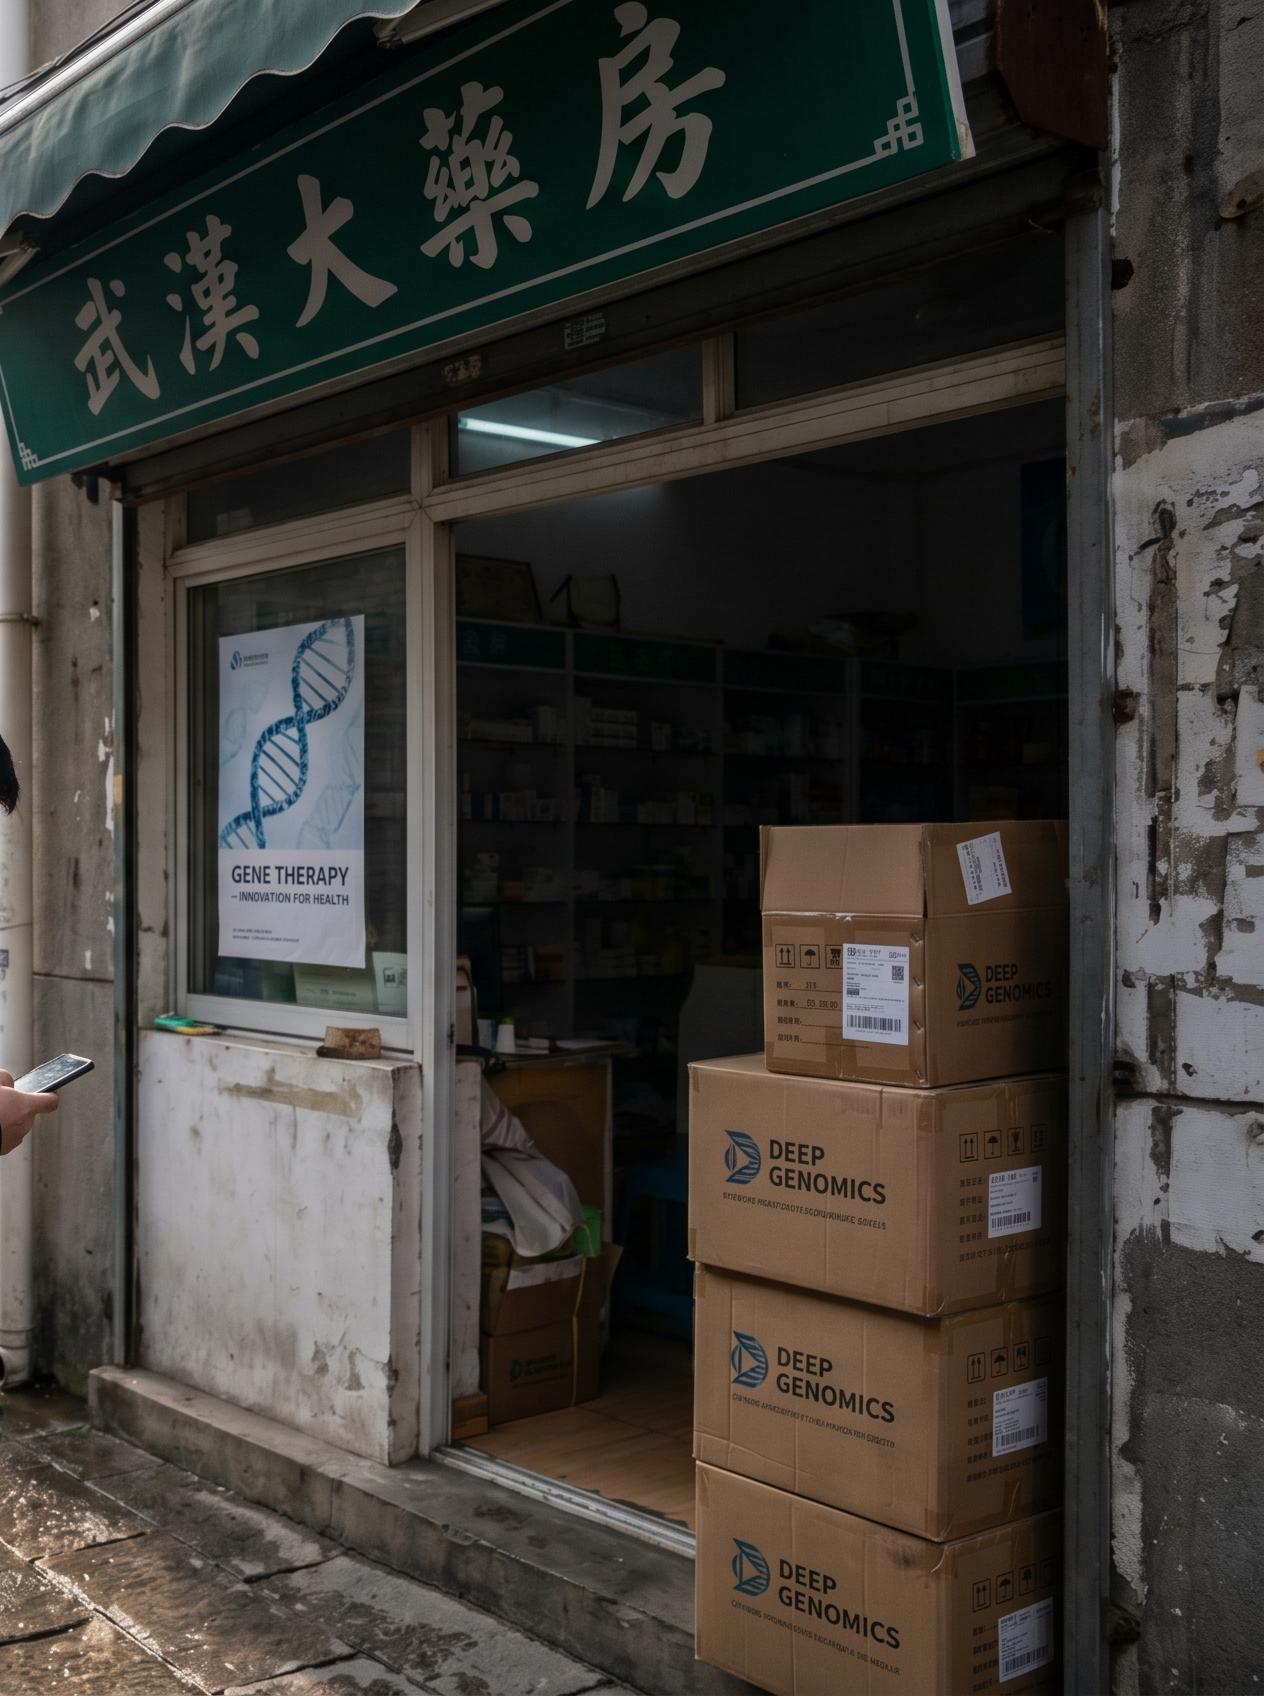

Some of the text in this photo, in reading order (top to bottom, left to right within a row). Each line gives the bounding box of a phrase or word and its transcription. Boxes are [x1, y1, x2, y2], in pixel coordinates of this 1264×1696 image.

[73, 1, 726, 415] 武漢大藥房
[231, 865, 349, 886] GENE THERAPY
[239, 892, 291, 904] INNOVATION
[293, 893, 311, 905] FOR
[313, 894, 349, 906] HEALTH
[985, 964, 1018, 982] DEEP
[769, 1138, 825, 1166] DEEP
[769, 1167, 887, 1205] GENOMICS
[777, 1346, 833, 1377] DEEP
[777, 1373, 895, 1424] GENOMICS
[779, 1558, 837, 1595] DEEP
[778, 1587, 901, 1650] GENOMICS
